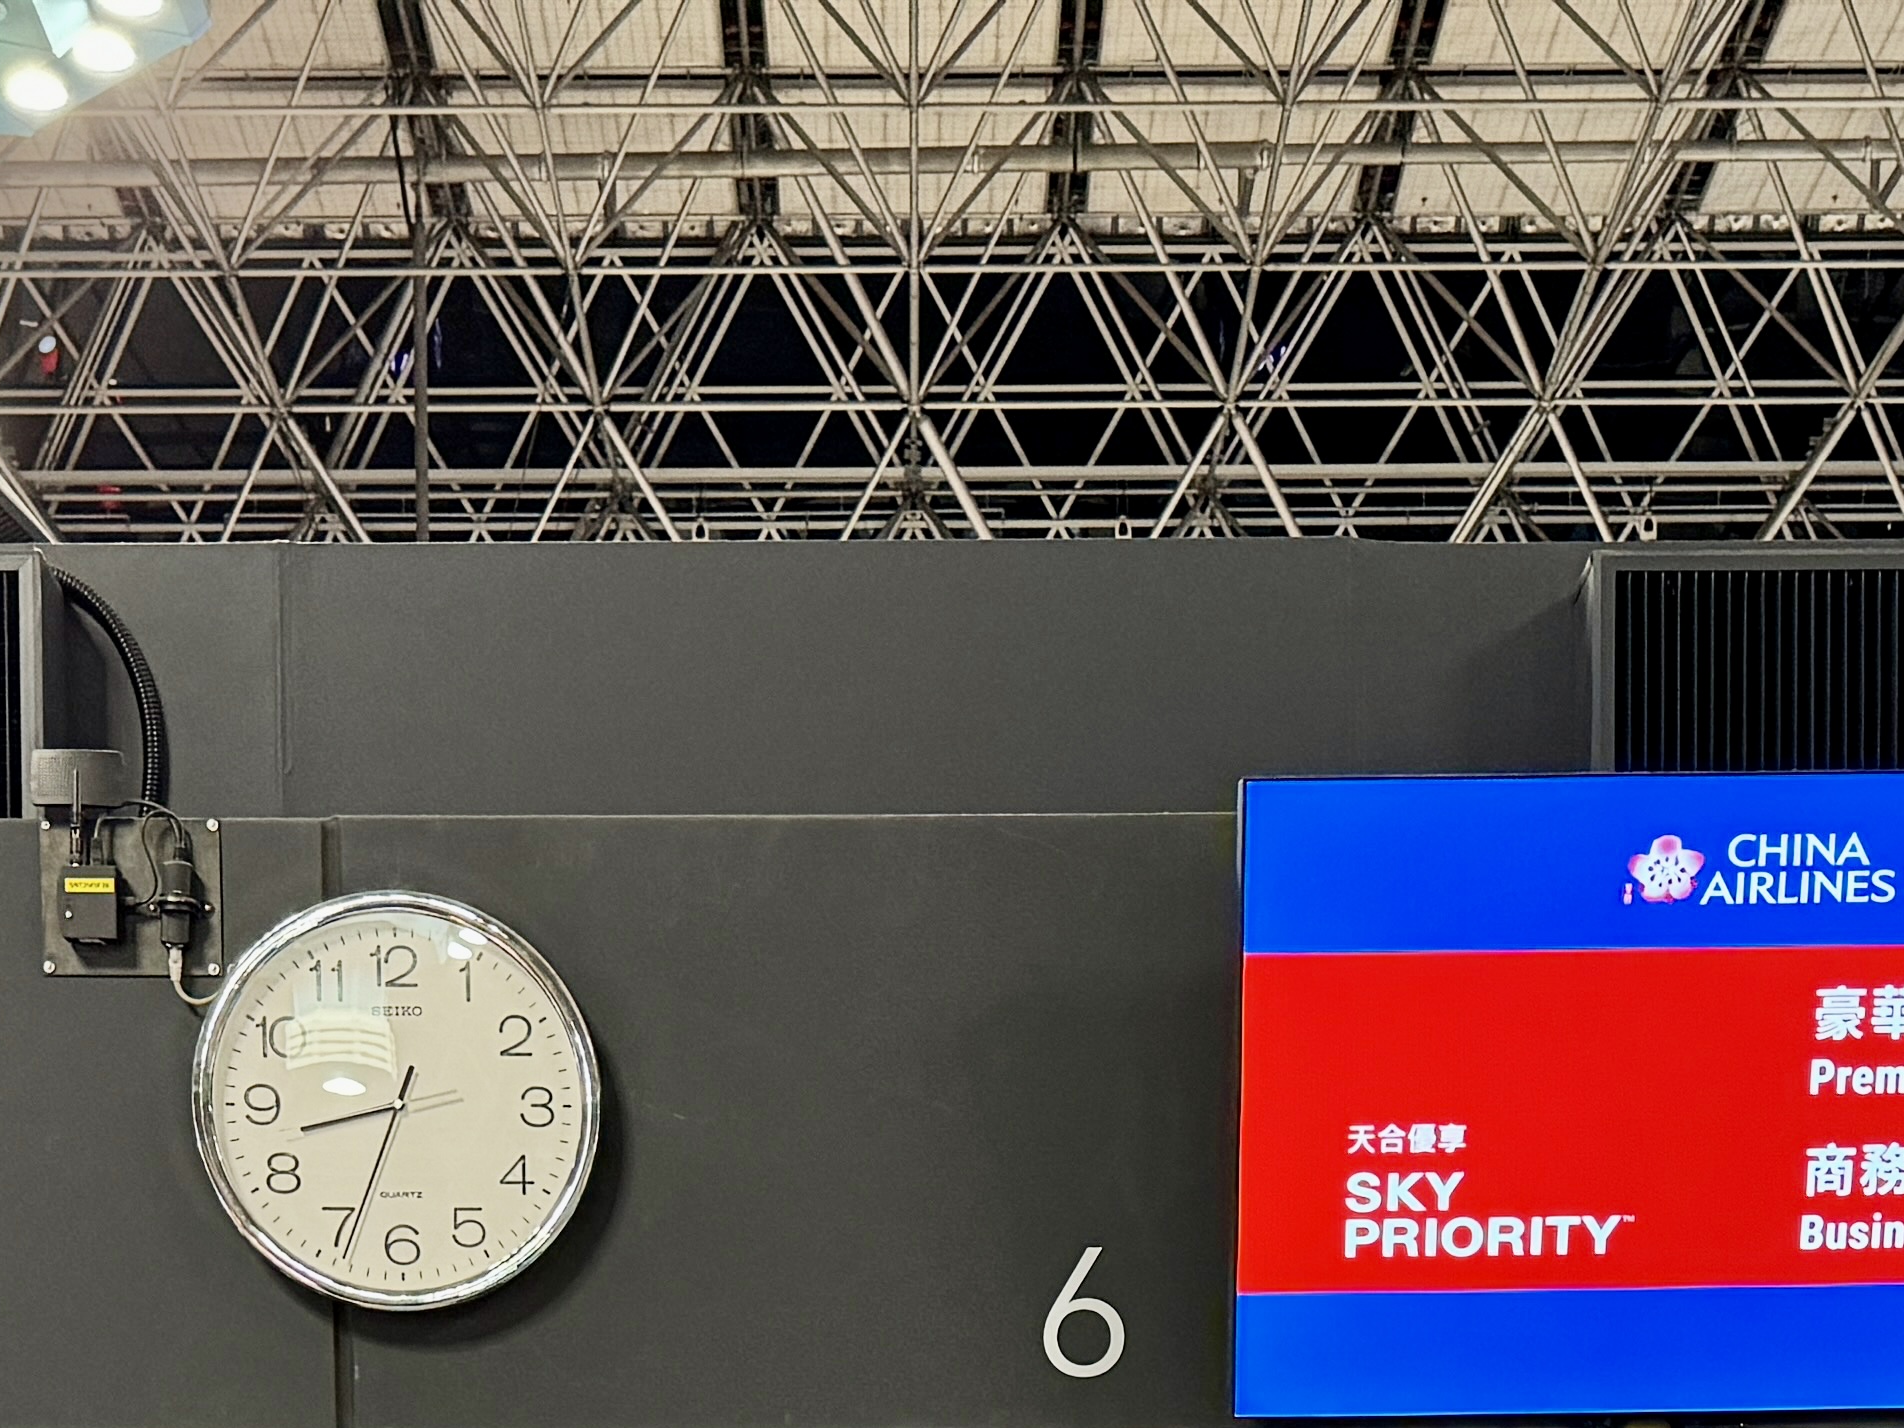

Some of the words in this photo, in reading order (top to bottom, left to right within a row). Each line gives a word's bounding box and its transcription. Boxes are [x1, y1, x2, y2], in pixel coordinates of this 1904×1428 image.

[1728, 831, 1870, 867] CHINA
[1699, 868, 1896, 906] AIRLINES
[309, 960, 343, 1001] 11
[369, 945, 418, 988] 12
[459, 960, 472, 1002] 1
[371, 1006, 423, 1017] SEIKO
[256, 1015, 307, 1058] 10
[499, 1014, 533, 1057] 2
[244, 1083, 281, 1125] 9
[520, 1086, 555, 1128] 3
[1347, 1122, 1467, 1154] 天合優享
[266, 1152, 302, 1194] 8
[499, 1154, 535, 1196] 4
[1344, 1171, 1465, 1214] SKY
[379, 1191, 424, 1199] QUARTZ
[322, 1206, 356, 1248] 7
[384, 1224, 421, 1266] 6
[452, 1207, 487, 1248] 5
[1042, 1246, 1126, 1378] 6
